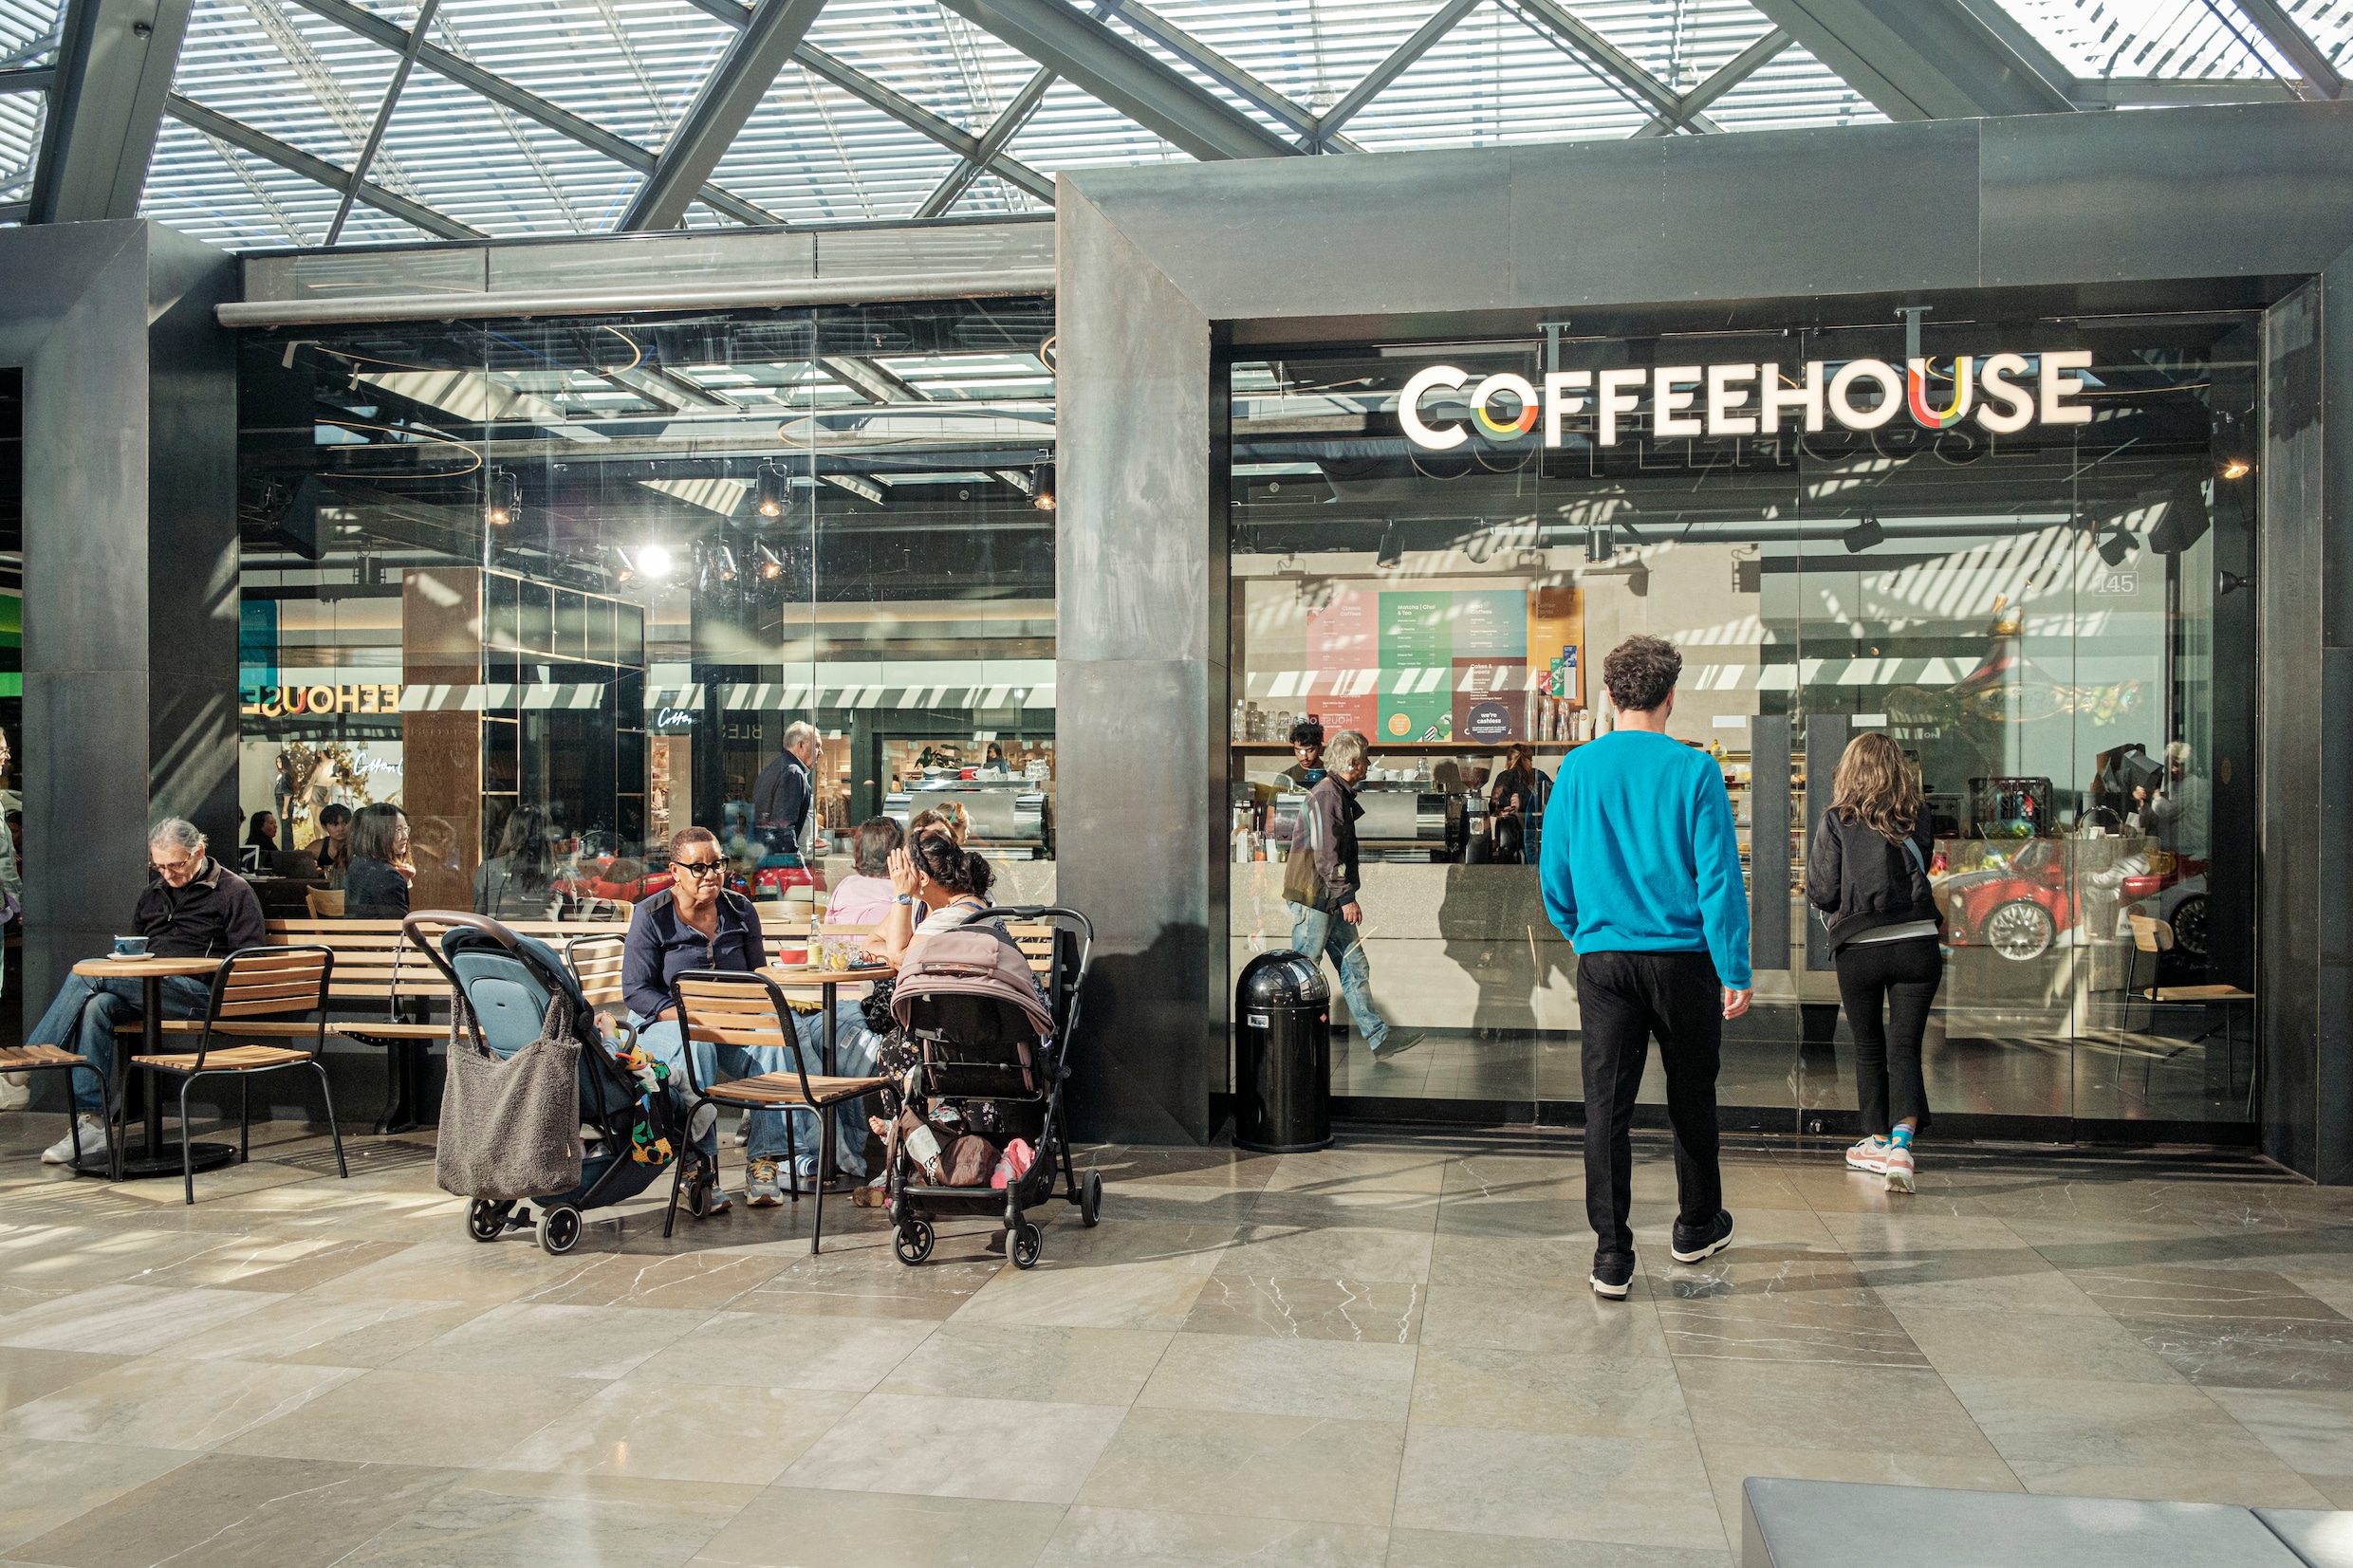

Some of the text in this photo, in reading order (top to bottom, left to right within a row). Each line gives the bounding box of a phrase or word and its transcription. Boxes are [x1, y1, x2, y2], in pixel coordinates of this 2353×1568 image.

[1398, 350, 2093, 450] COFFEEHOUSE
[2095, 575, 2134, 593] 145
[353, 752, 398, 777] Cotton
